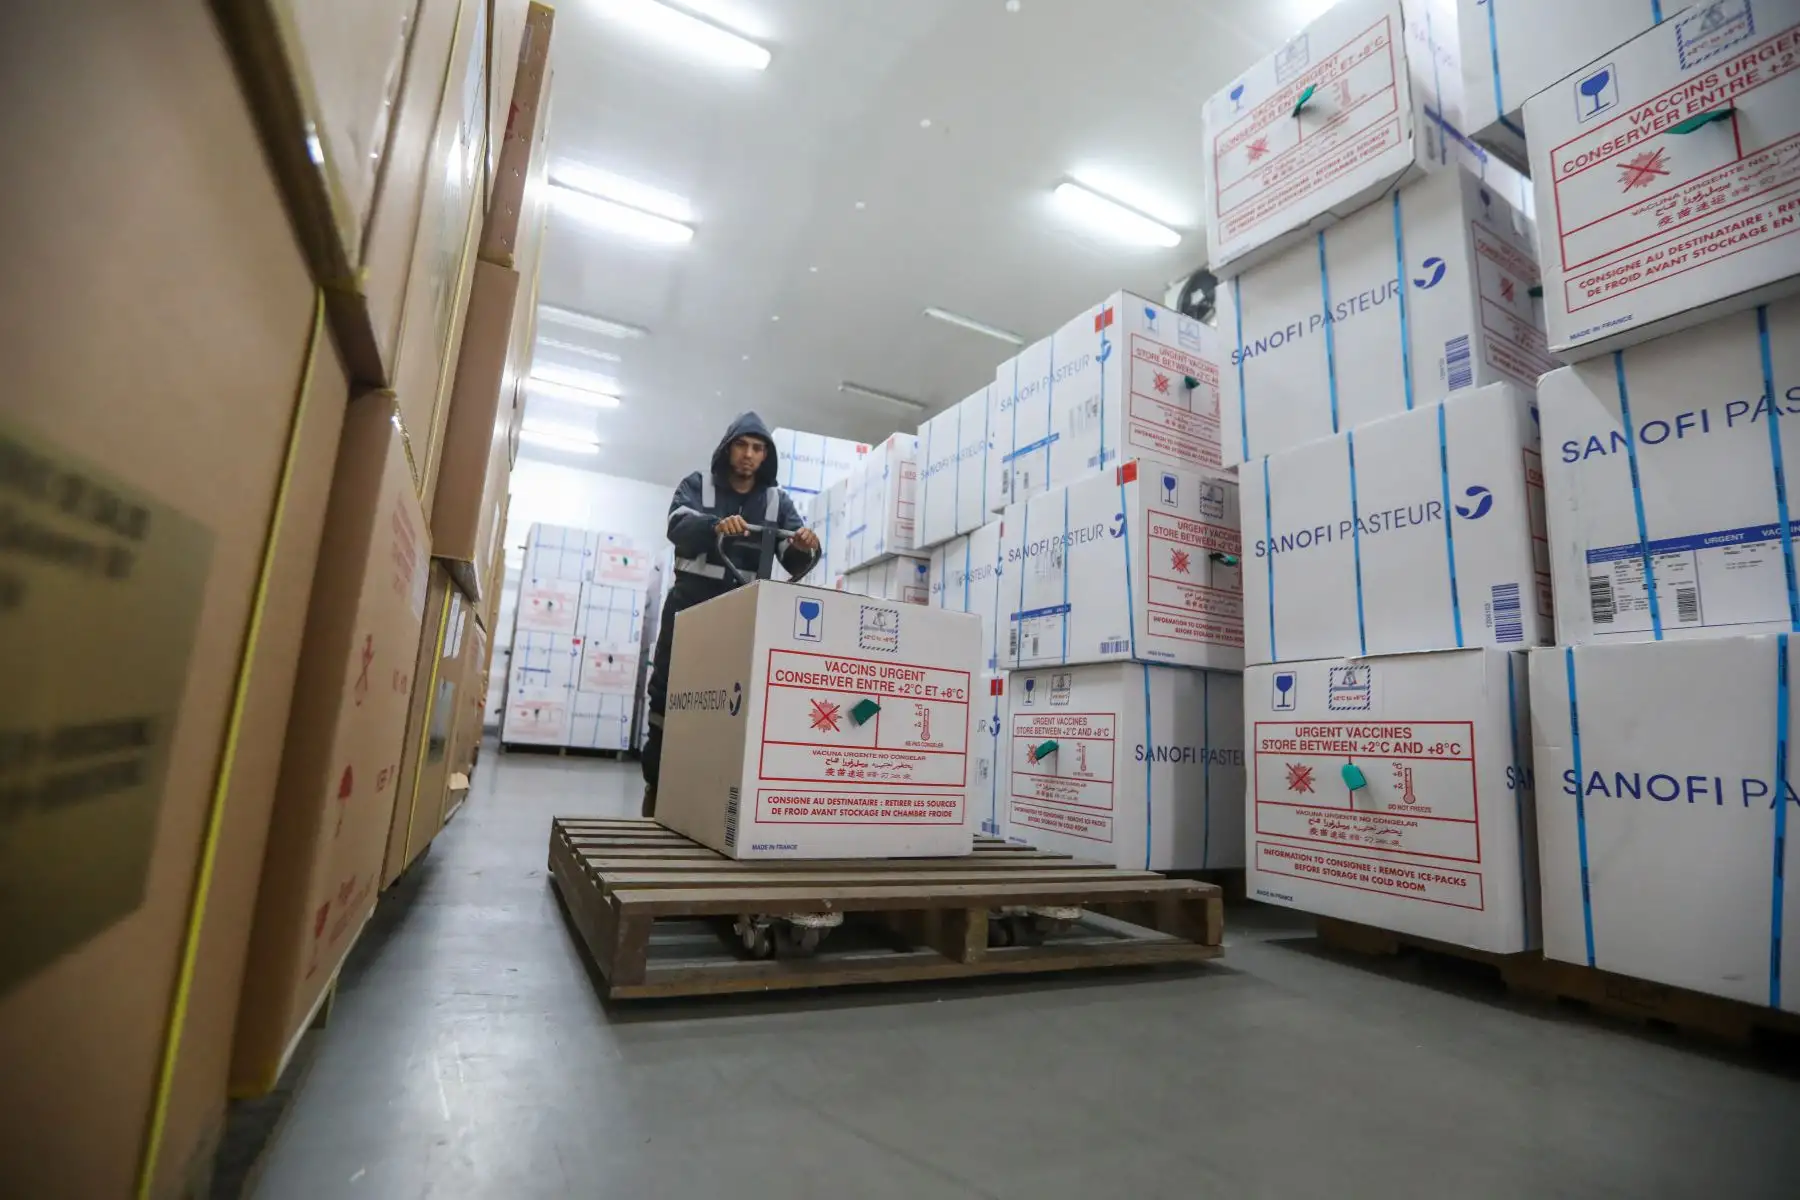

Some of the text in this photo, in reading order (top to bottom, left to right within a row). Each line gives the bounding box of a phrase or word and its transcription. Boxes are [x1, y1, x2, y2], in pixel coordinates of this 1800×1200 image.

[1629, 74, 1719, 125] VACCINS
[1562, 109, 1686, 174] CONSERVER
[1687, 69, 1761, 115] ENTRE
[1579, 259, 1642, 290] CONSIGNE
[1645, 251, 1665, 265] AU
[1668, 213, 1764, 256] DESTINATAIRE
[1587, 215, 1794, 298] DE FROID AVANT STOCKAGE EN
[1230, 278, 1401, 366] SANOFI PASTEUR
[1000, 385, 1040, 412] SANOFI
[1562, 408, 1709, 463] SANOFI
[1153, 525, 1178, 538] STORE
[1180, 531, 1216, 549] BETWEEN
[1177, 521, 1208, 535] URGENT
[1255, 500, 1442, 558] SANOFI PASTEUR
[1704, 533, 1745, 545] URGENT
[1008, 522, 1104, 563] SANOFI PASTEUR
[824, 660, 926, 681] VACCINS URGENT
[775, 669, 964, 700] CONSERVER ENTRE +2°C ET +8°C
[668, 689, 727, 711] SANOFI PASTEUR
[1016, 726, 1034, 735] STORE
[1034, 726, 1062, 735] BETWEEN
[1077, 727, 1092, 736] AND
[1032, 717, 1088, 725] URGENT VACCINES
[1295, 727, 1412, 739] URGENT VACCINES
[1135, 743, 1196, 764] SANOFI
[1262, 739, 1461, 755] STORE BETWEEN +2°C AND +8°C
[1562, 769, 1723, 806] SANOFI
[767, 796, 811, 805] CONSIGNE
[813, 797, 825, 805] AU
[827, 798, 878, 807] DESTINATAIRE
[885, 799, 912, 808] RETIRER
[914, 800, 925, 808] LES
[926, 800, 957, 808] SOURCES
[771, 807, 952, 817] DE FROID AVANT STOCKAGE EN CHAMBRE FROIDE
[1359, 815, 1372, 823] NO
[1373, 816, 1418, 828] CONGELAR
[1263, 848, 1312, 862] INFORMATION
[1314, 856, 1324, 864] TO
[1326, 858, 1371, 871] CONSIGNEE
[1378, 866, 1415, 879] REMOVE
[1417, 871, 1467, 887] ICE-PACKS
[1294, 864, 1426, 892] BEFORE STORAGE IN COLD ROOM
